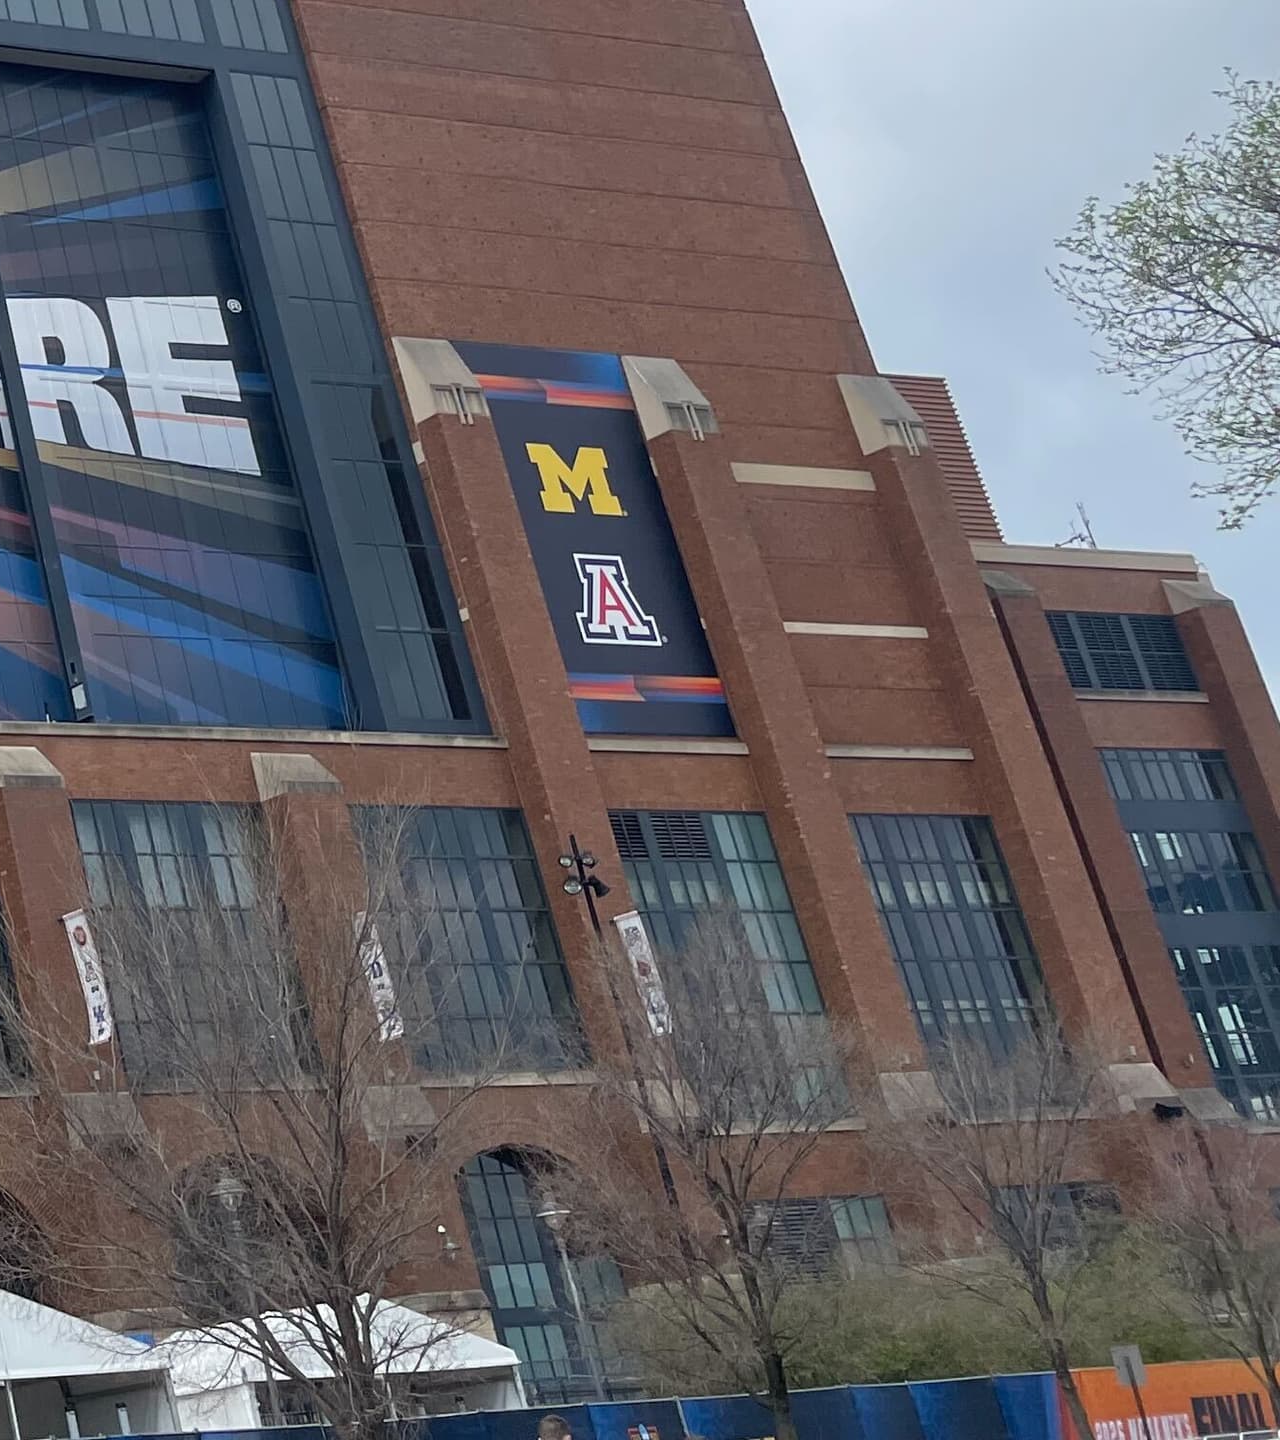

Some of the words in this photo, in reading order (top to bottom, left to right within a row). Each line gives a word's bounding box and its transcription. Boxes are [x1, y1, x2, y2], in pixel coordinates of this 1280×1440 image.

[525, 442, 625, 517] M
[573, 553, 663, 647] A
[1191, 1392, 1271, 1437] FINAL
